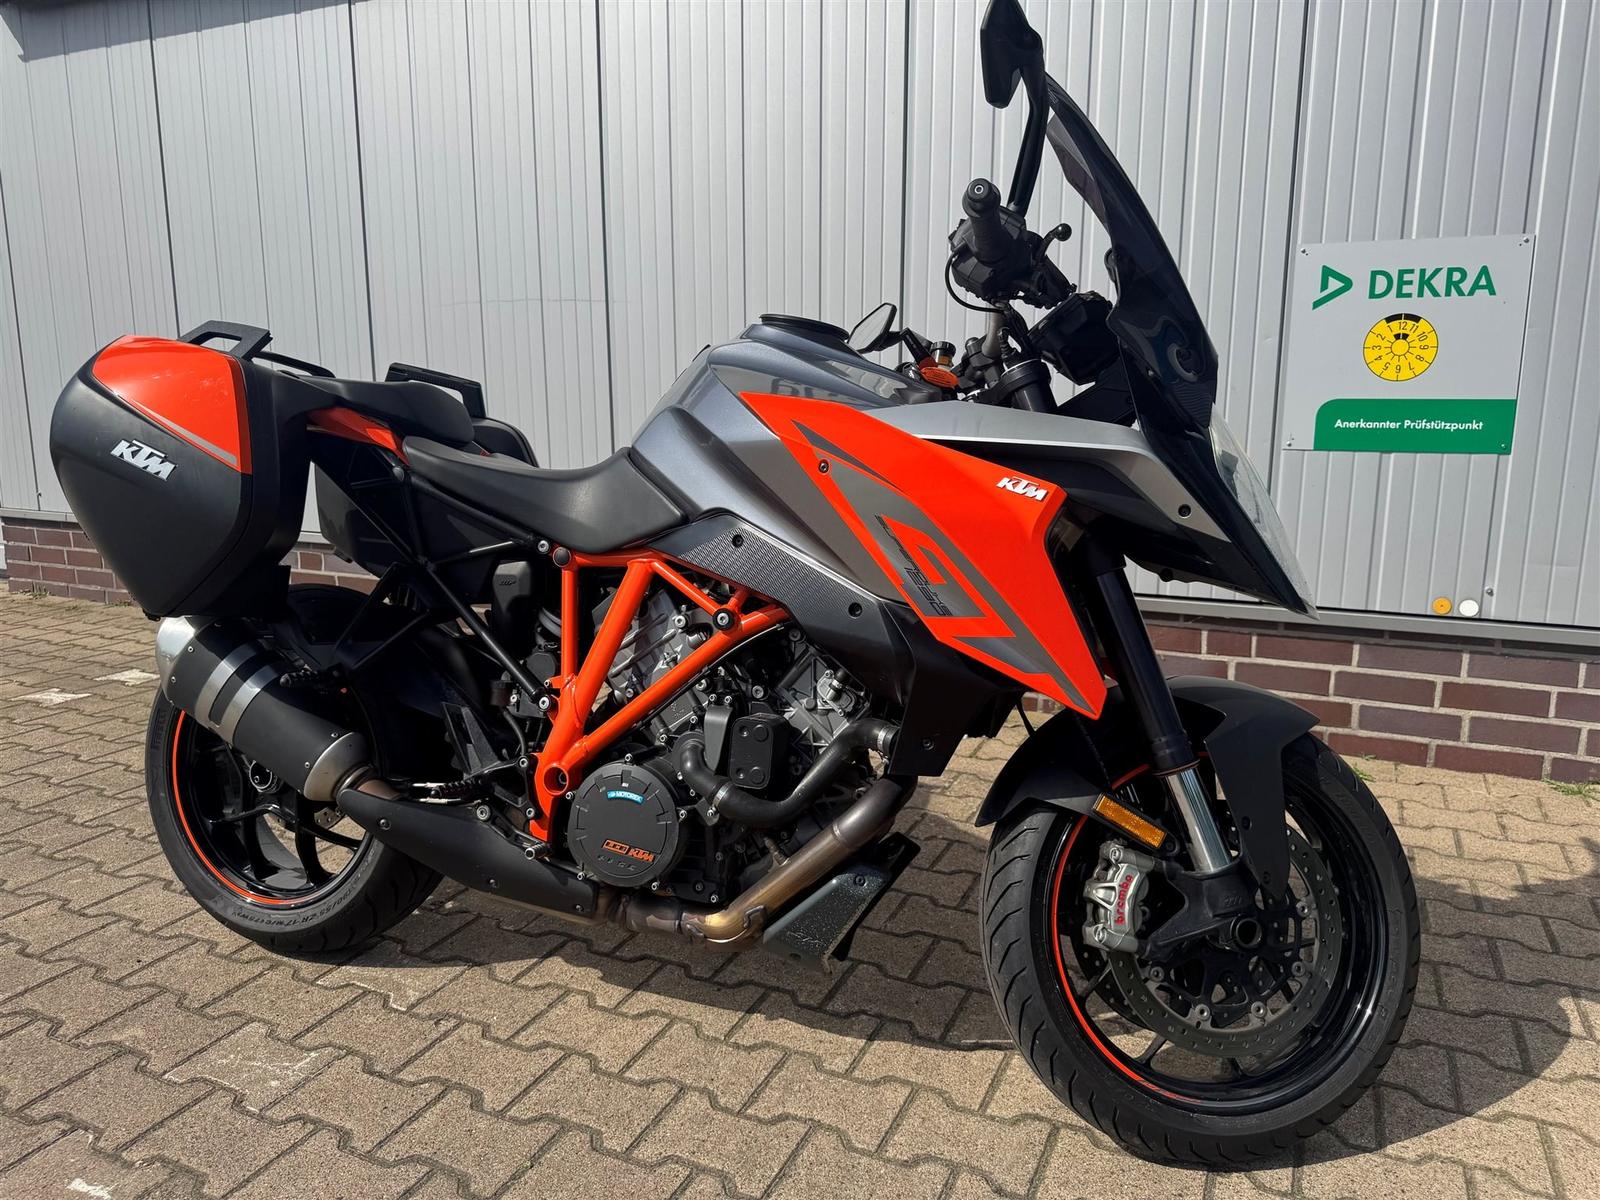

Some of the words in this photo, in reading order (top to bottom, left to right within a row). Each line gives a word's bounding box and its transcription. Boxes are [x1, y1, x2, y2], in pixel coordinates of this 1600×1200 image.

[1368, 265, 1497, 299] DEKRA
[1398, 321, 1408, 330] 12
[1410, 323, 1419, 333] 11
[1376, 333, 1386, 341] 2
[1416, 331, 1428, 342] 10
[1415, 354, 1425, 362] 8
[1382, 362, 1391, 371] 5
[1395, 364, 1401, 374] 6
[1408, 361, 1415, 371] 7
[1334, 418, 1401, 429] Anerkannter
[1404, 419, 1484, 432] Prüfstützpunkt
[110, 439, 177, 481] KTM
[995, 475, 1048, 502] KTM
[1114, 874, 1134, 925] brembo
